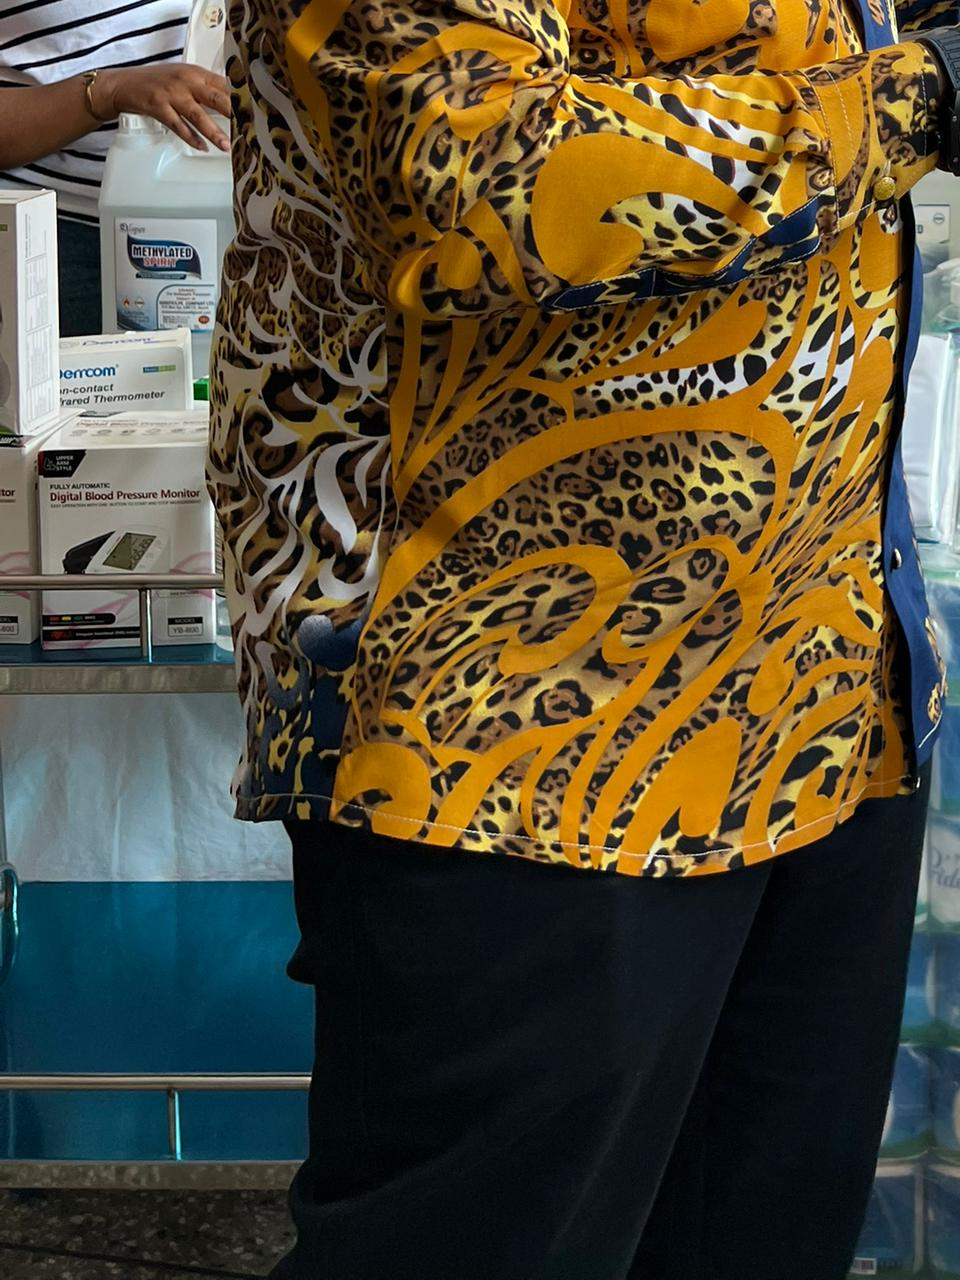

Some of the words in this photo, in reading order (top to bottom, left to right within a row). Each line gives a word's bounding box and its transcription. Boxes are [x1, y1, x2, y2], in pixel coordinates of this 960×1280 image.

[131, 245, 193, 258] METHYLATED
[143, 257, 177, 268] SPIRIT
[94, 391, 165, 404] Thermometer
[71, 482, 111, 490] AUTOMATIC
[50, 491, 82, 504] Digital
[85, 491, 114, 501] Blood
[117, 490, 158, 500] Pressure
[161, 488, 201, 499] Monitor
